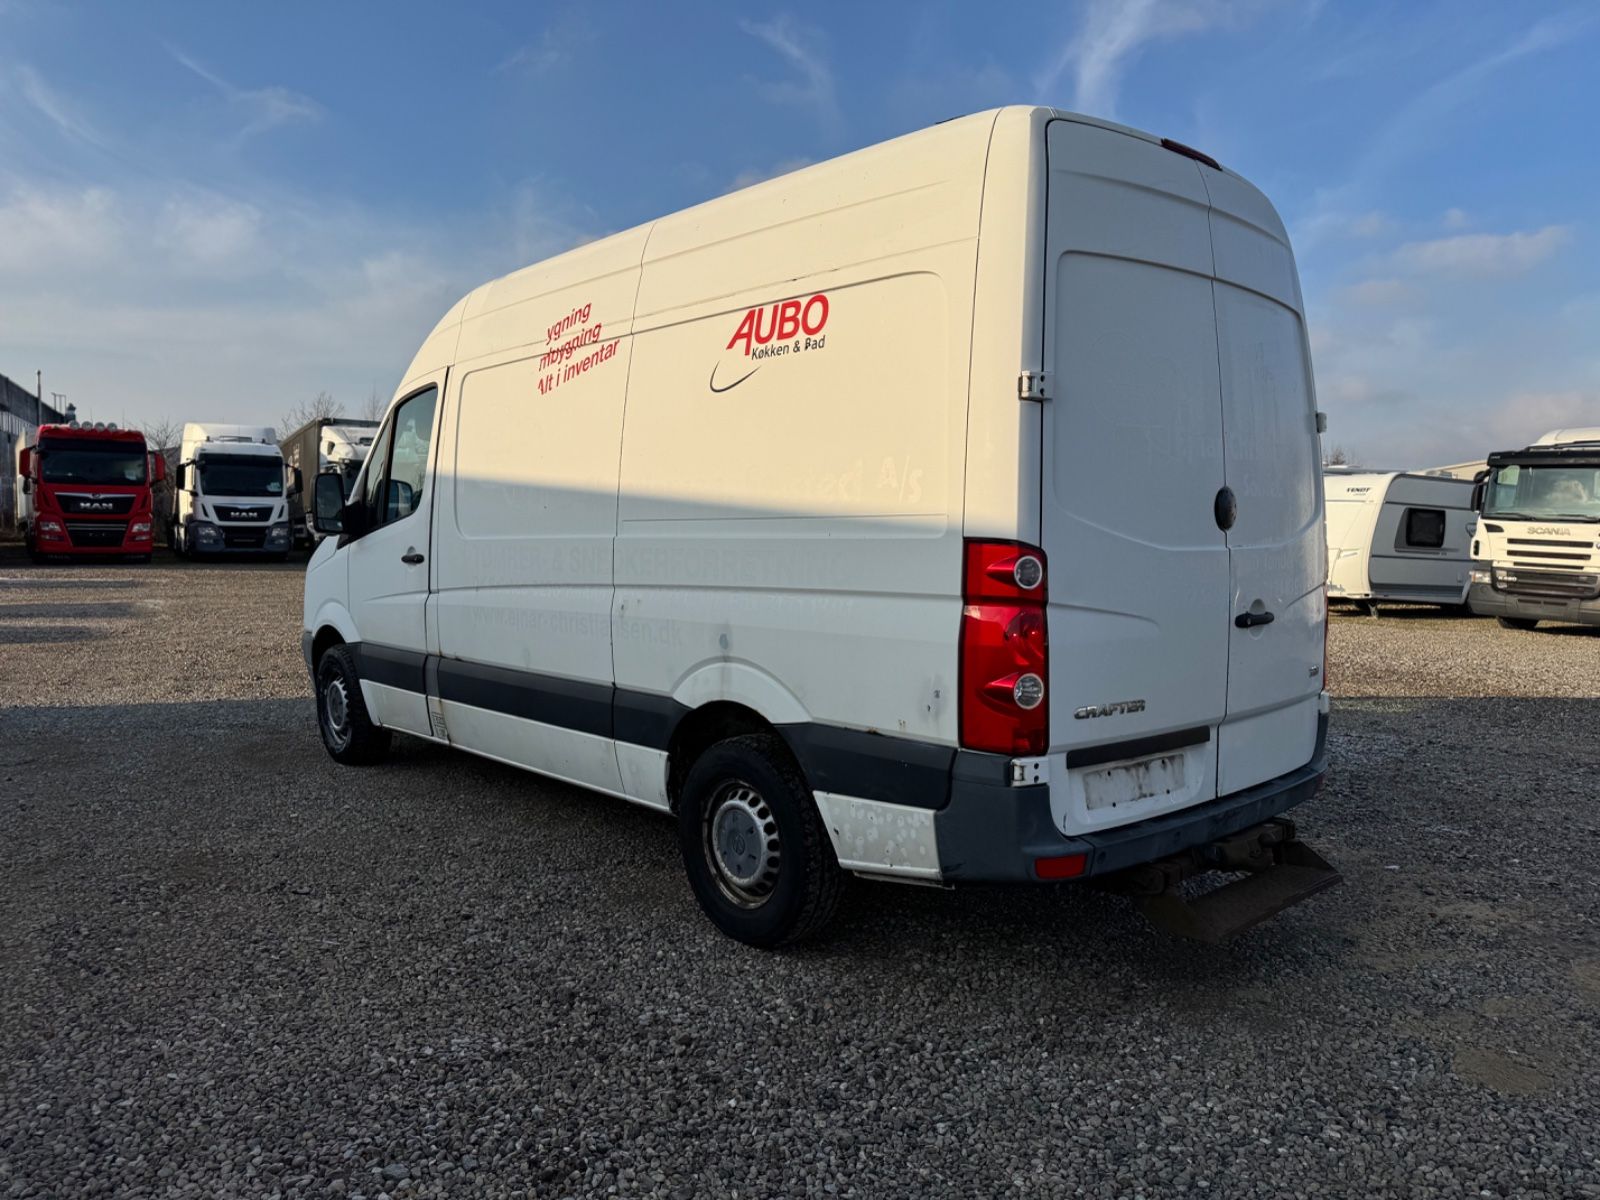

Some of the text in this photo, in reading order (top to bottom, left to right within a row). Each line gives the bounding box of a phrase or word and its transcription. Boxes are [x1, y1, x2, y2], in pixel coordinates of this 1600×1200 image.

[546, 302, 592, 346] ygning
[726, 293, 829, 356] AUBO
[751, 334, 826, 361] Køkken & Bad
[556, 367, 561, 387] i
[563, 339, 620, 383] inventar
[80, 501, 113, 510] MAN
[1527, 526, 1571, 537] SCANIA
[1074, 699, 1146, 720] CRAFTER
